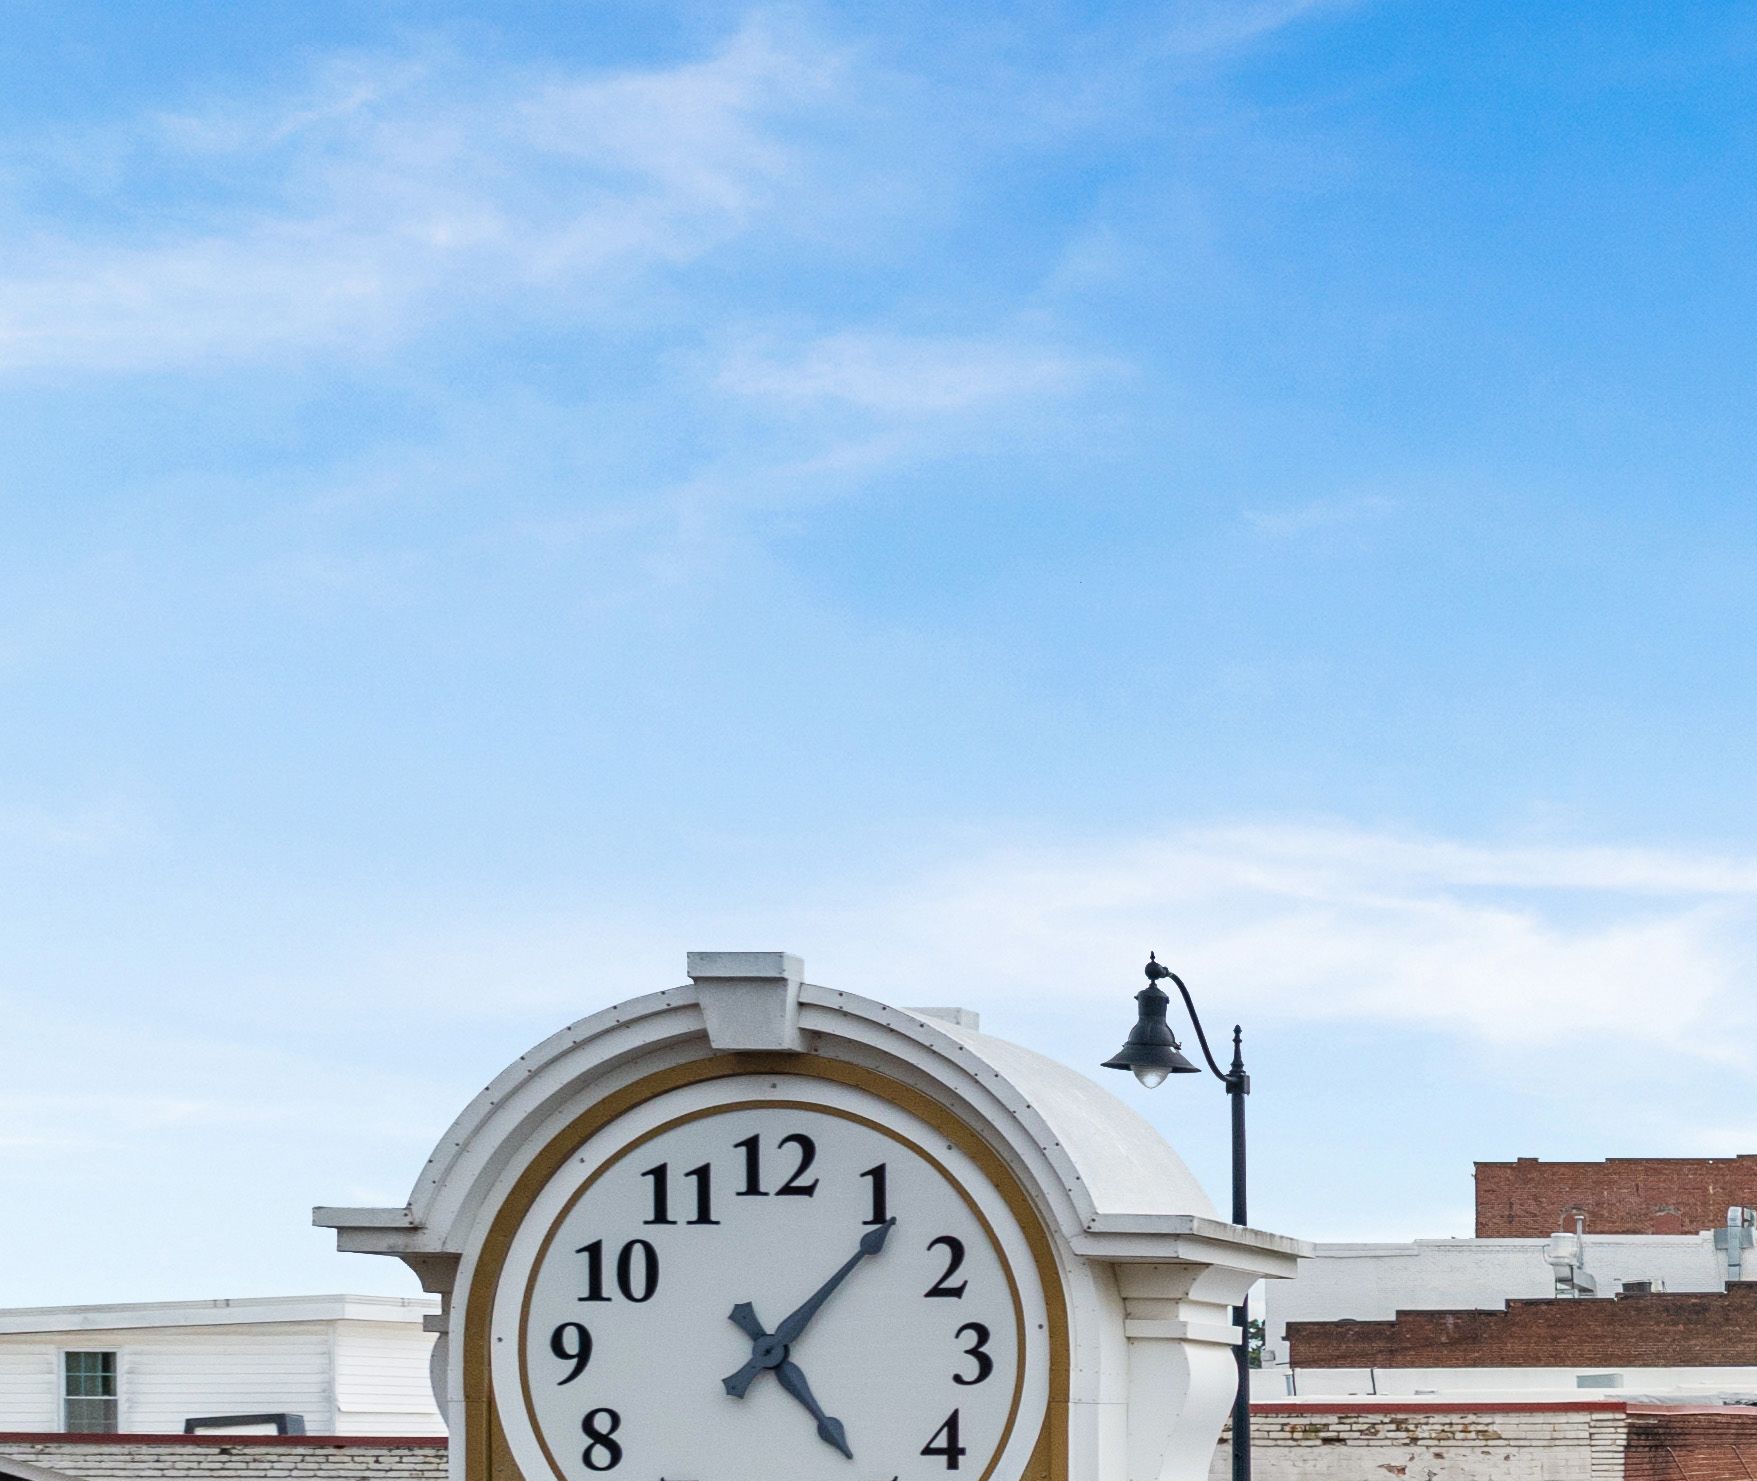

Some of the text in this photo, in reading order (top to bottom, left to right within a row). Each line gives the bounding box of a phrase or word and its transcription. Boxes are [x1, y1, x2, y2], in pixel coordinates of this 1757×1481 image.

[641, 1162, 721, 1226] 11
[733, 1133, 819, 1198] 12
[860, 1163, 888, 1226] 1
[576, 1239, 659, 1303] 10
[924, 1236, 968, 1299] 2
[550, 1322, 593, 1385] 9
[952, 1322, 993, 1385] 3
[581, 1407, 623, 1471] 8
[920, 1409, 967, 1470] 4
